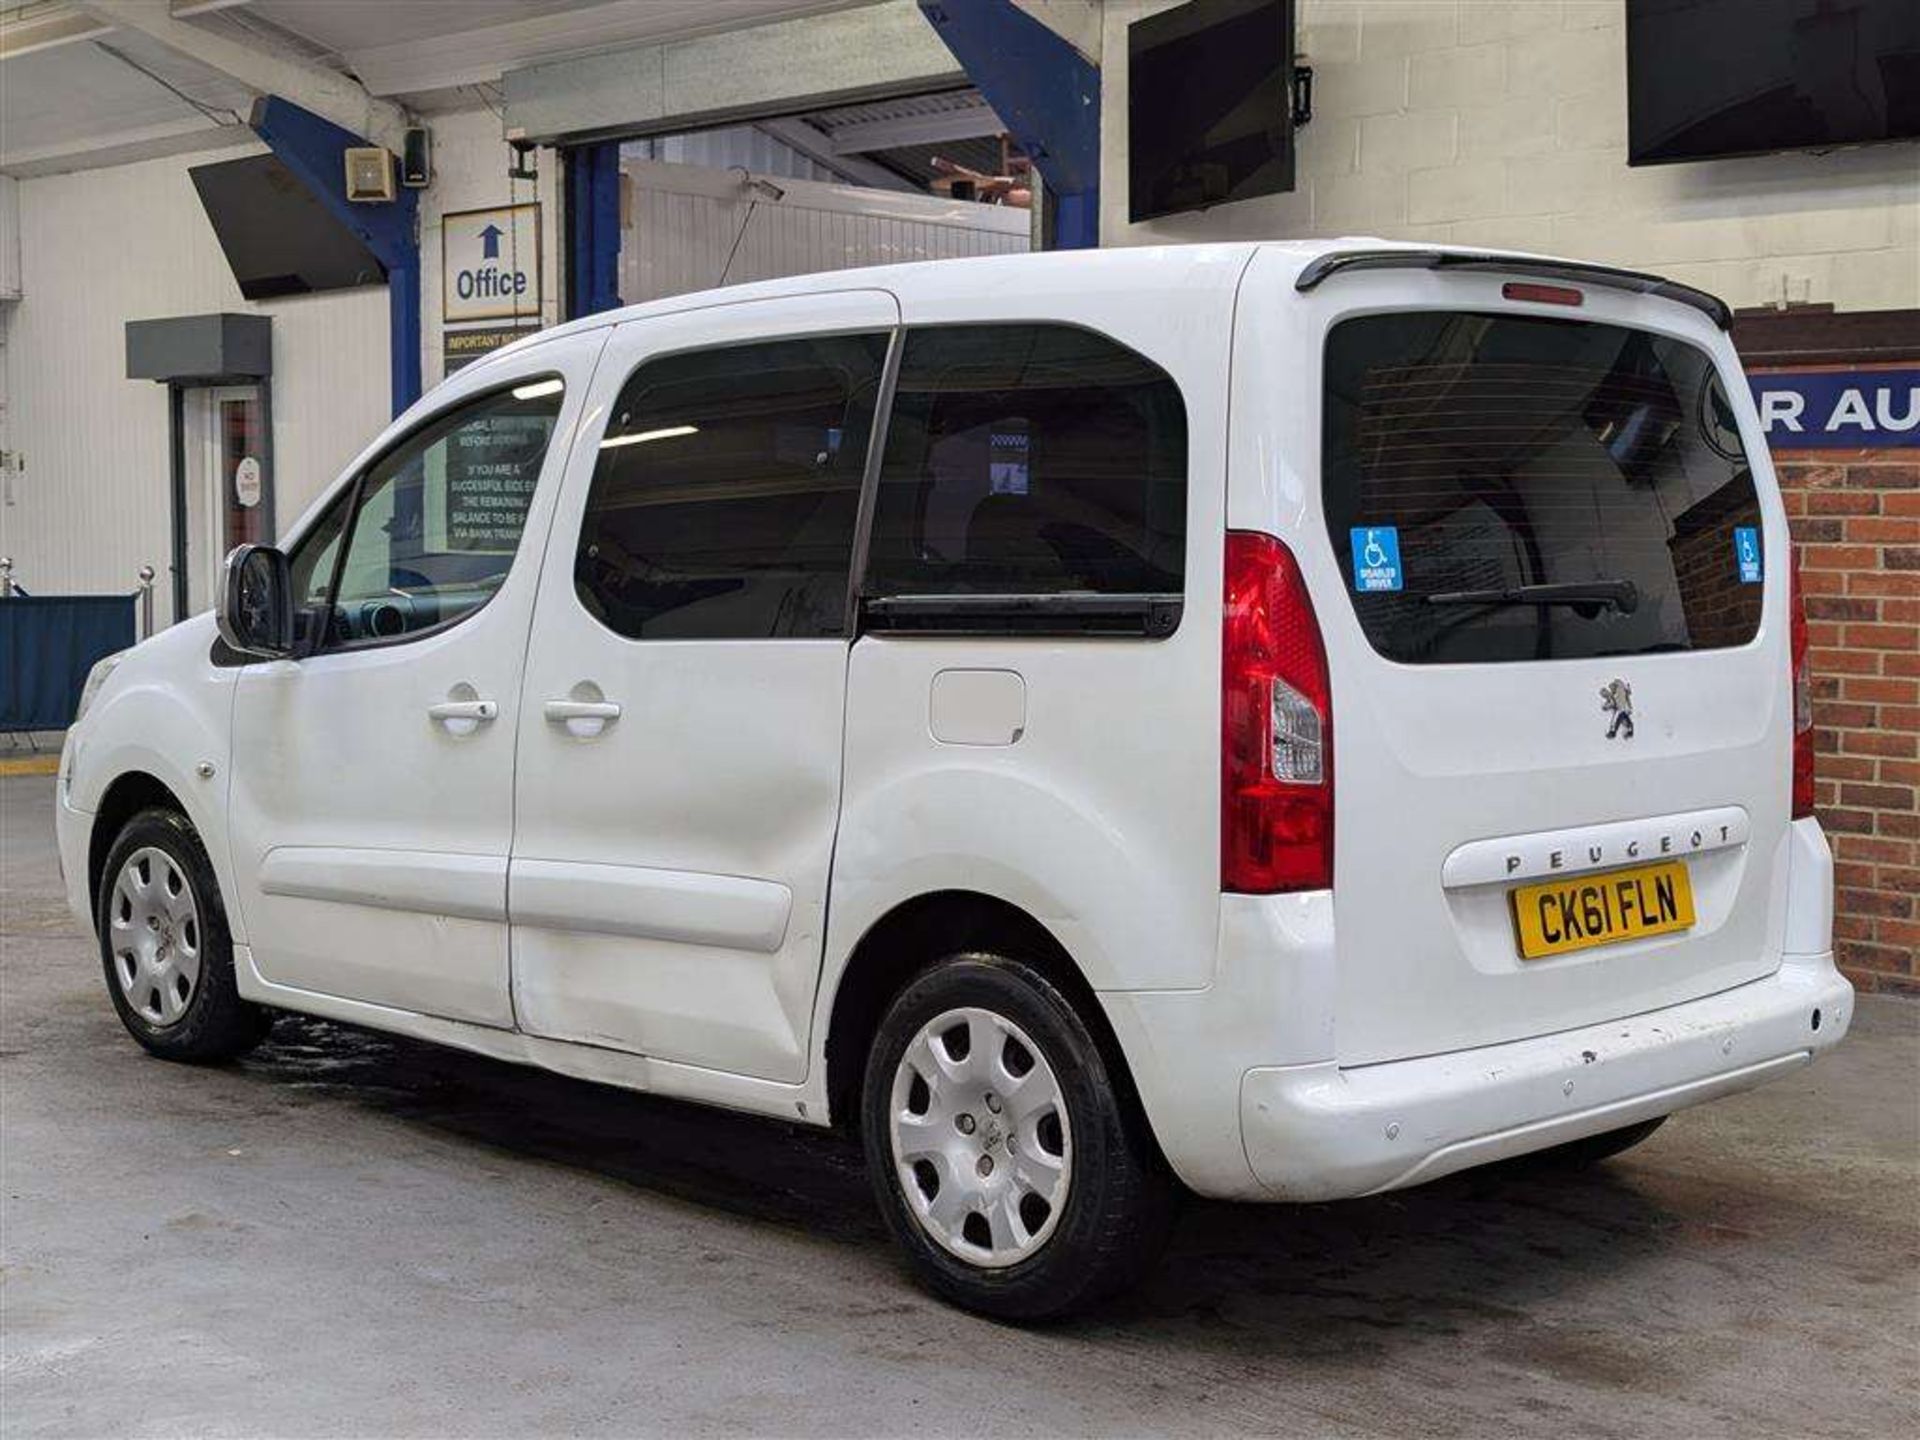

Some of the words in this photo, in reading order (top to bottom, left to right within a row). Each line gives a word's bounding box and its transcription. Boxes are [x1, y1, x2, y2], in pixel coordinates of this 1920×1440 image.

[456, 266, 527, 300] Office
[449, 334, 501, 349] IMPORTANT
[1824, 387, 1920, 432] AU
[477, 464, 494, 476] YOU
[495, 464, 512, 476] ARE
[462, 495, 478, 507] THE
[452, 512, 492, 524] BALANCE
[492, 512, 504, 524] TO
[453, 528, 468, 539] VIA
[468, 528, 494, 539] BANK
[1506, 825, 1729, 874] PEUGEOT
[1537, 885, 1614, 945] CK61
[1619, 874, 1678, 930] FLN
